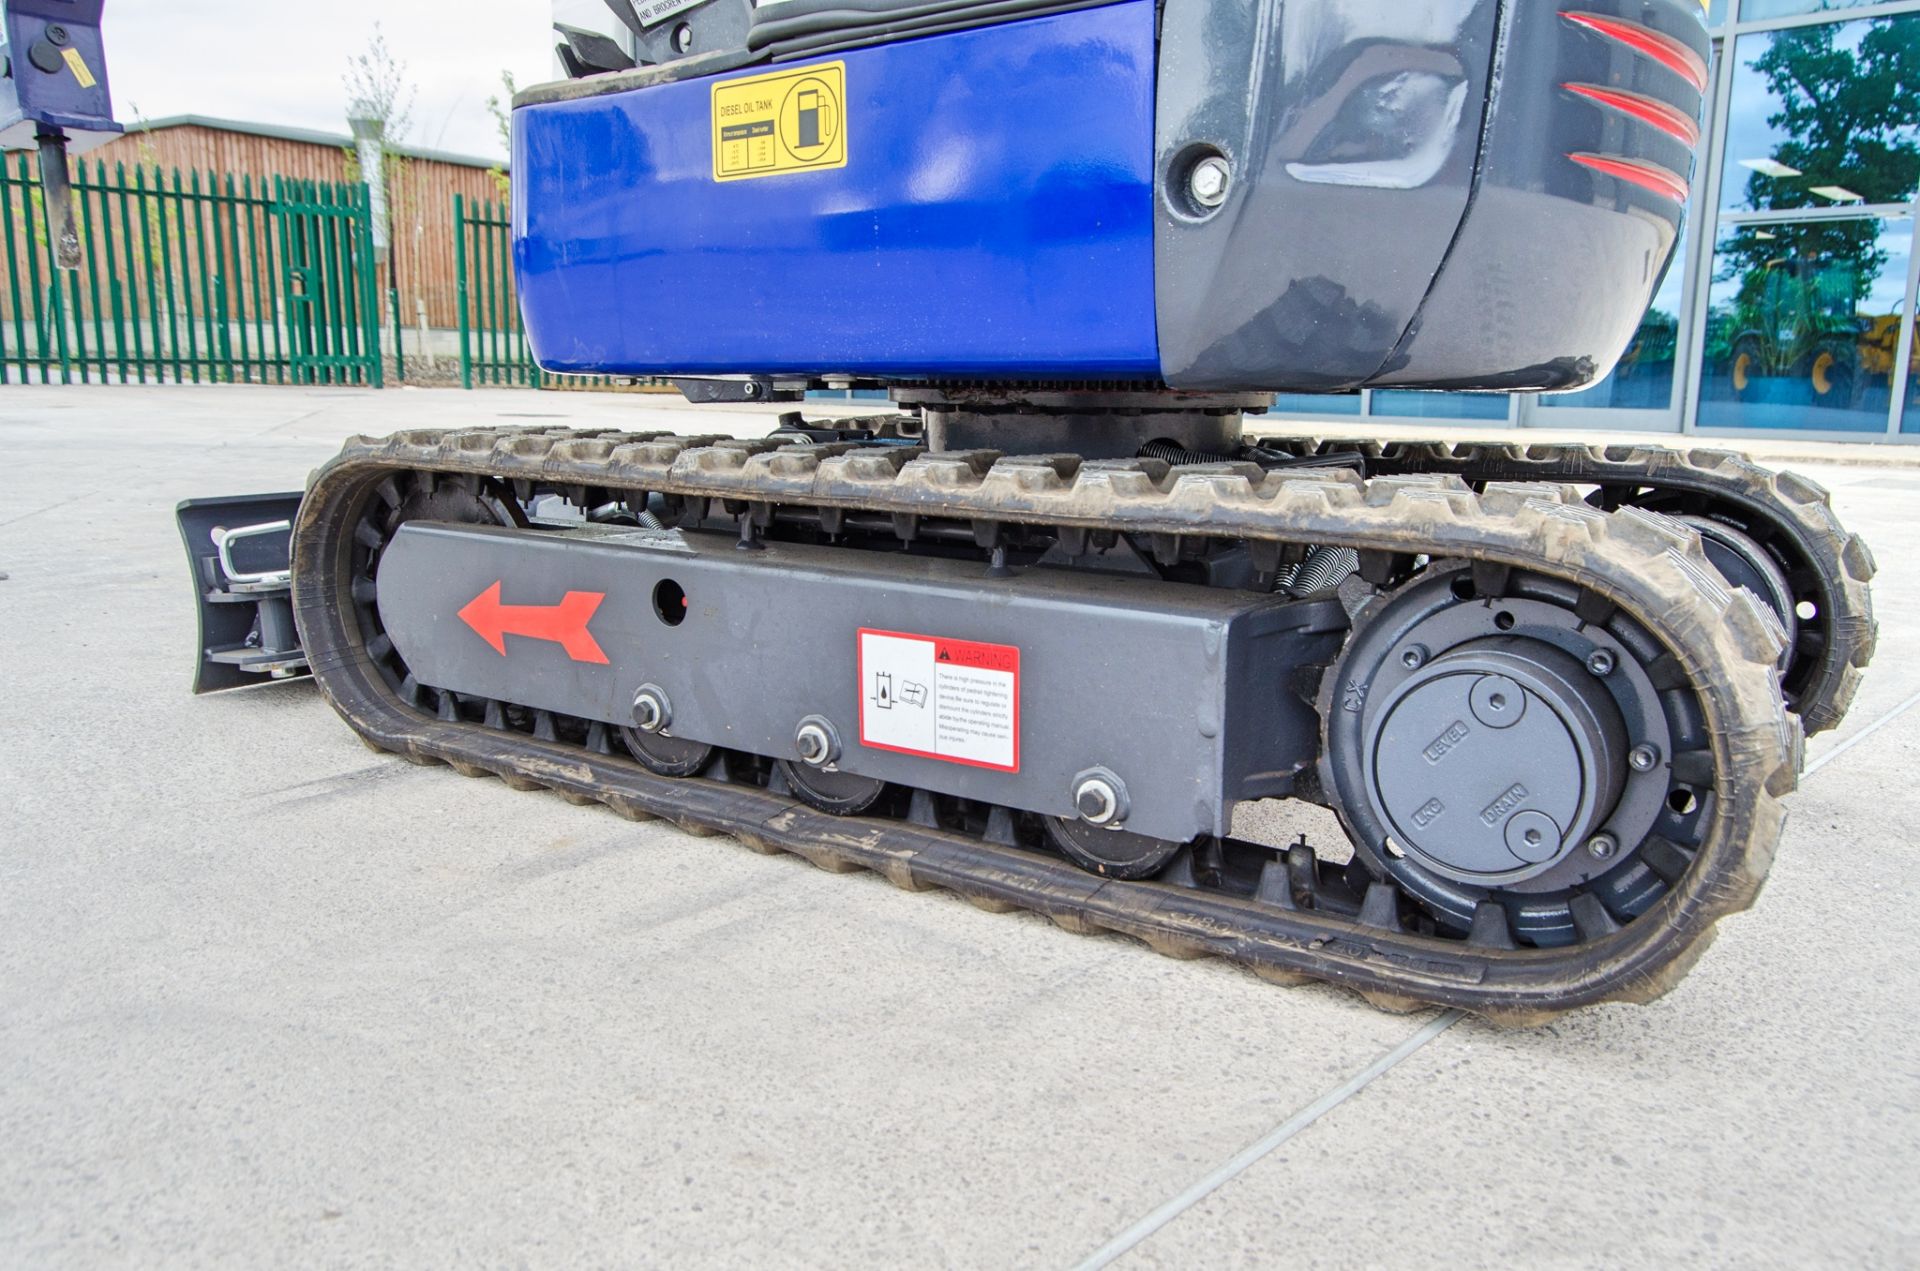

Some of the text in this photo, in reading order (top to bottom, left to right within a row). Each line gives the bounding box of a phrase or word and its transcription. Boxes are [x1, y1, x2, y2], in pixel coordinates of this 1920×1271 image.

[639, 8, 652, 20] AND
[720, 99, 773, 117] DIESEL OIL TANK
[954, 648, 1011, 669] WARNING
[1425, 722, 1468, 761] LEVEL
[1483, 786, 1526, 824] DRAIN
